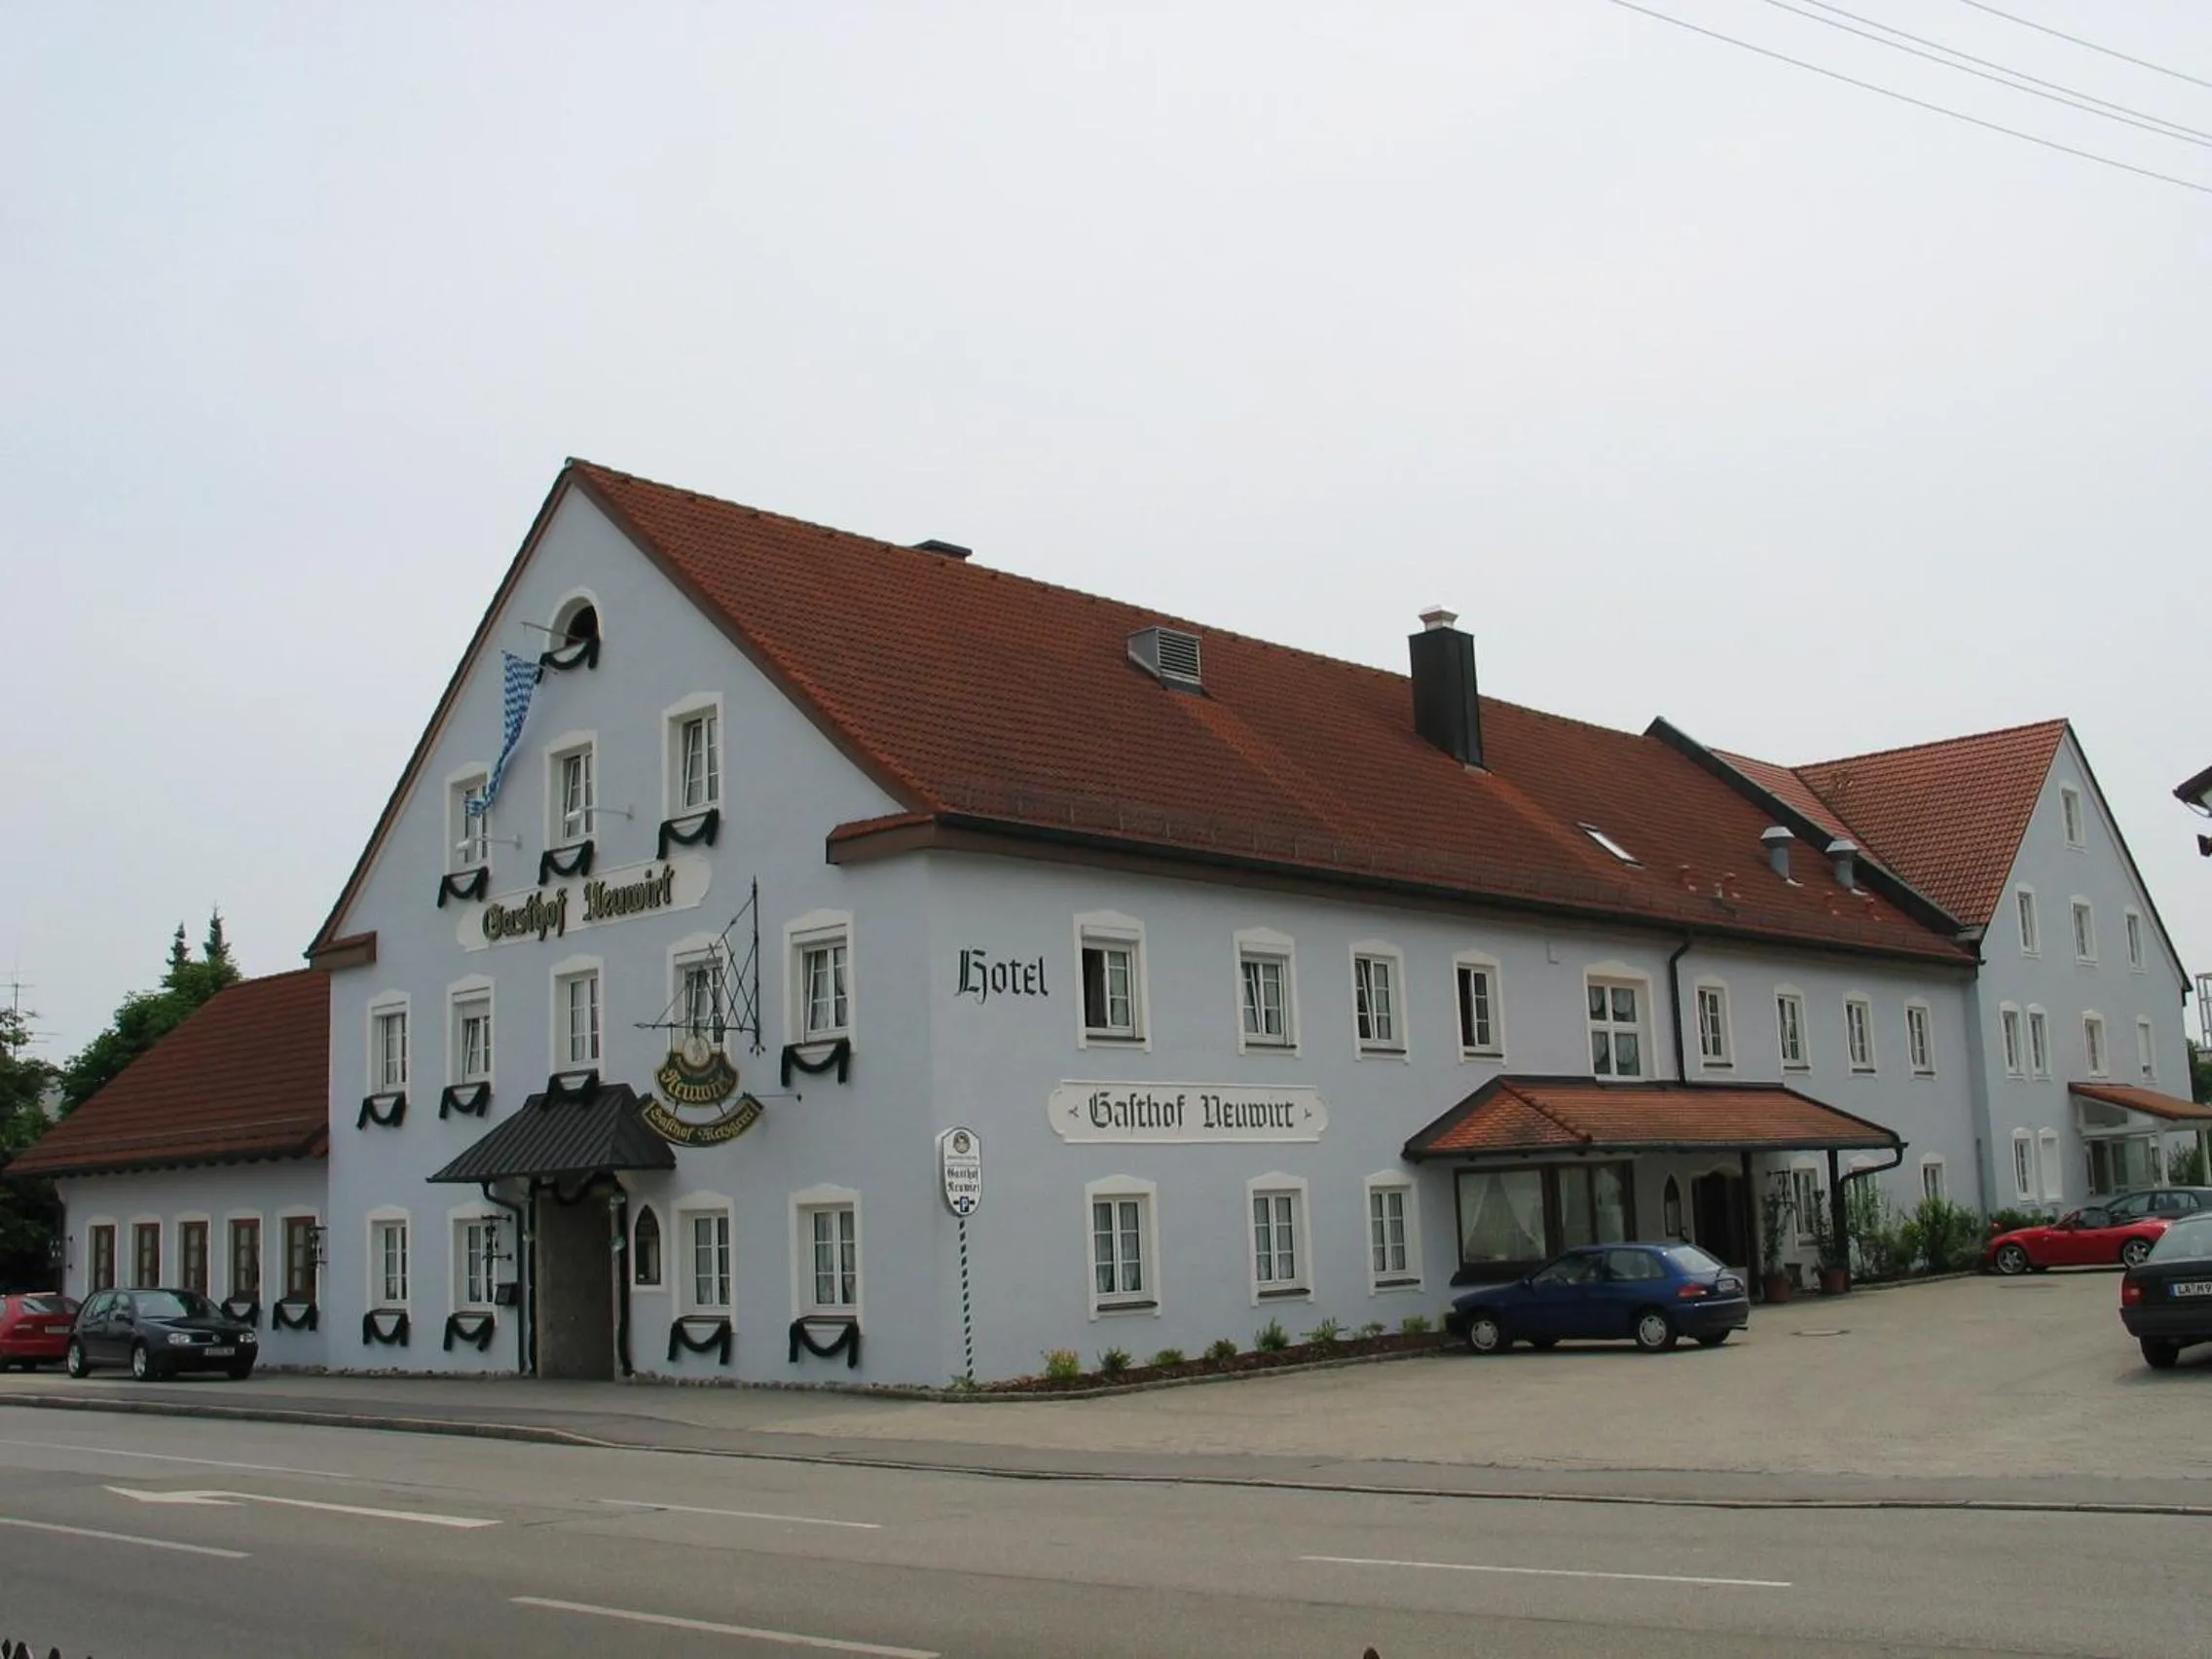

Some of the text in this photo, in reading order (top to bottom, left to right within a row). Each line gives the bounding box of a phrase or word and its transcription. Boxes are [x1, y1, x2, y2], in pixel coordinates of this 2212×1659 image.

[582, 865, 676, 921] Neuwirt
[954, 949, 1049, 1005] Hotel
[1200, 1094, 1295, 1128] Neuwirt
